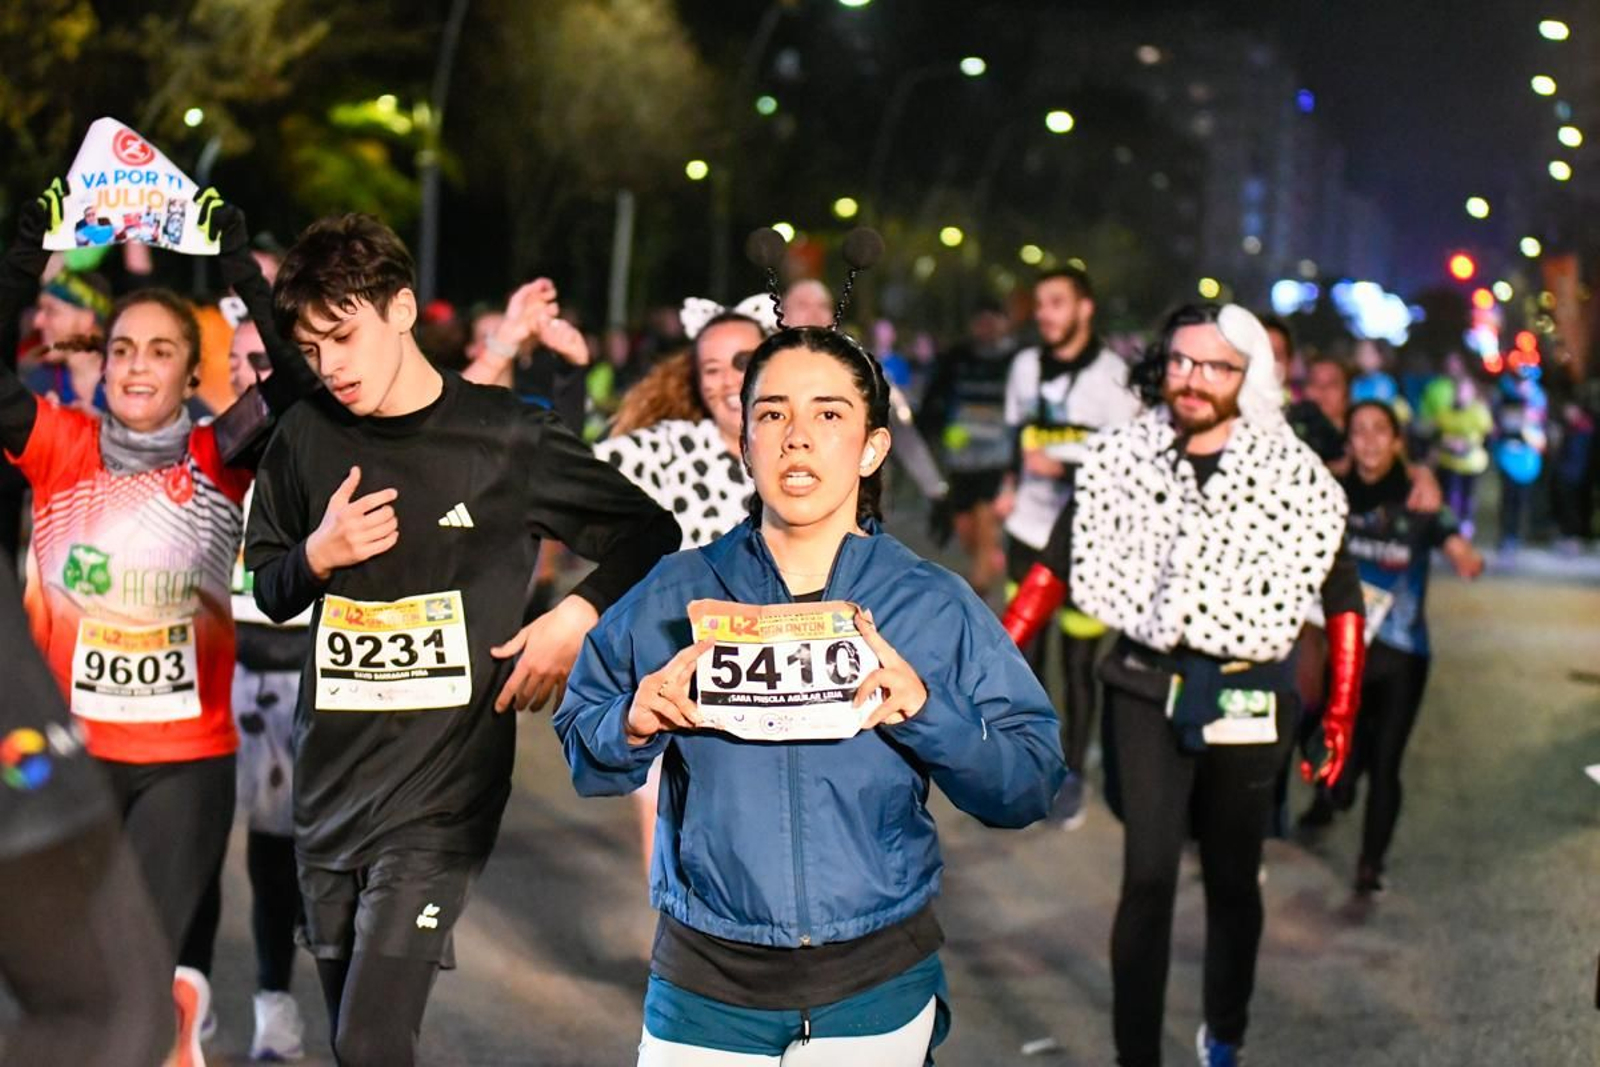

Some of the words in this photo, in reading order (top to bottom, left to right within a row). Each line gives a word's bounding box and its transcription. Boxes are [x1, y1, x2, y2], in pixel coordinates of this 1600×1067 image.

[81, 171, 108, 189] VA
[114, 169, 159, 185] POR
[165, 173, 182, 190] TI
[97, 187, 164, 210] JULIO
[327, 629, 447, 669] 9231
[711, 640, 861, 690] 5410
[85, 651, 185, 685] 9603
